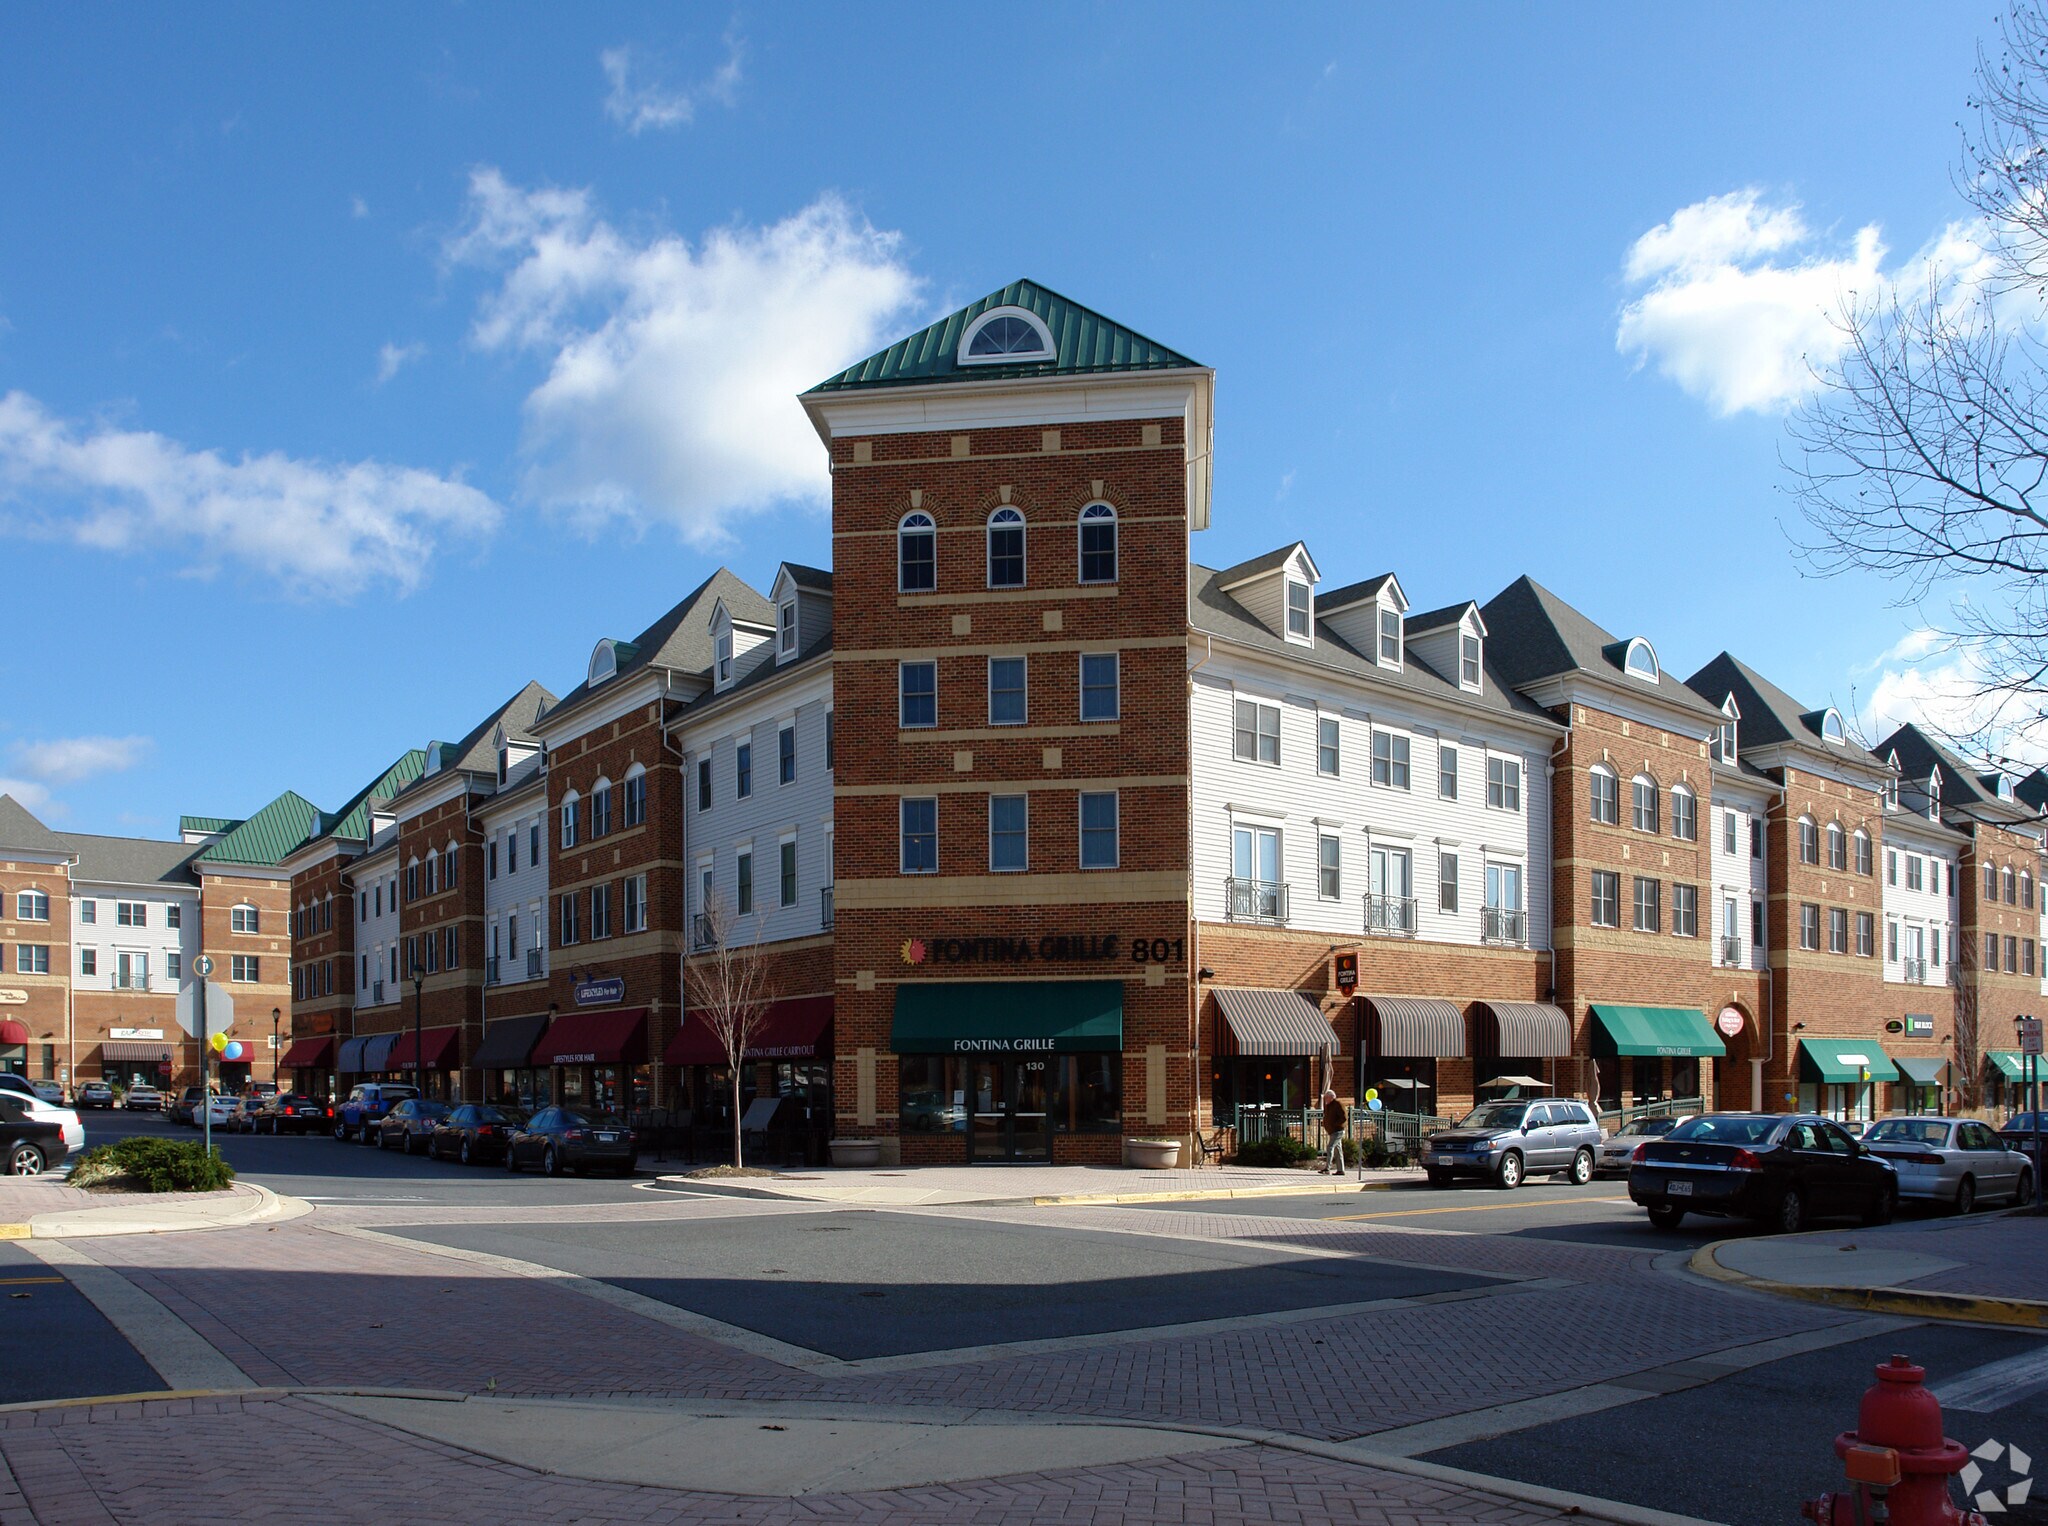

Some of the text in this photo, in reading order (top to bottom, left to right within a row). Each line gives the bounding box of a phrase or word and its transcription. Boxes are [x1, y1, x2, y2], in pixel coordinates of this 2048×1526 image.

[931, 934, 1118, 963] FONTINA GRILLE
[1131, 938, 1184, 963] 801
[202, 962, 209, 974] P
[580, 987, 604, 998] LIFESTYLES
[2028, 1022, 2037, 1030] NO
[954, 1038, 1055, 1051] FONTINA GRILLE
[743, 1047, 764, 1057] ONTINA
[764, 1046, 783, 1056] GRILLE
[553, 1053, 595, 1063] LIFESTYLES FOR HAIR
[1025, 1061, 1045, 1071] 130
